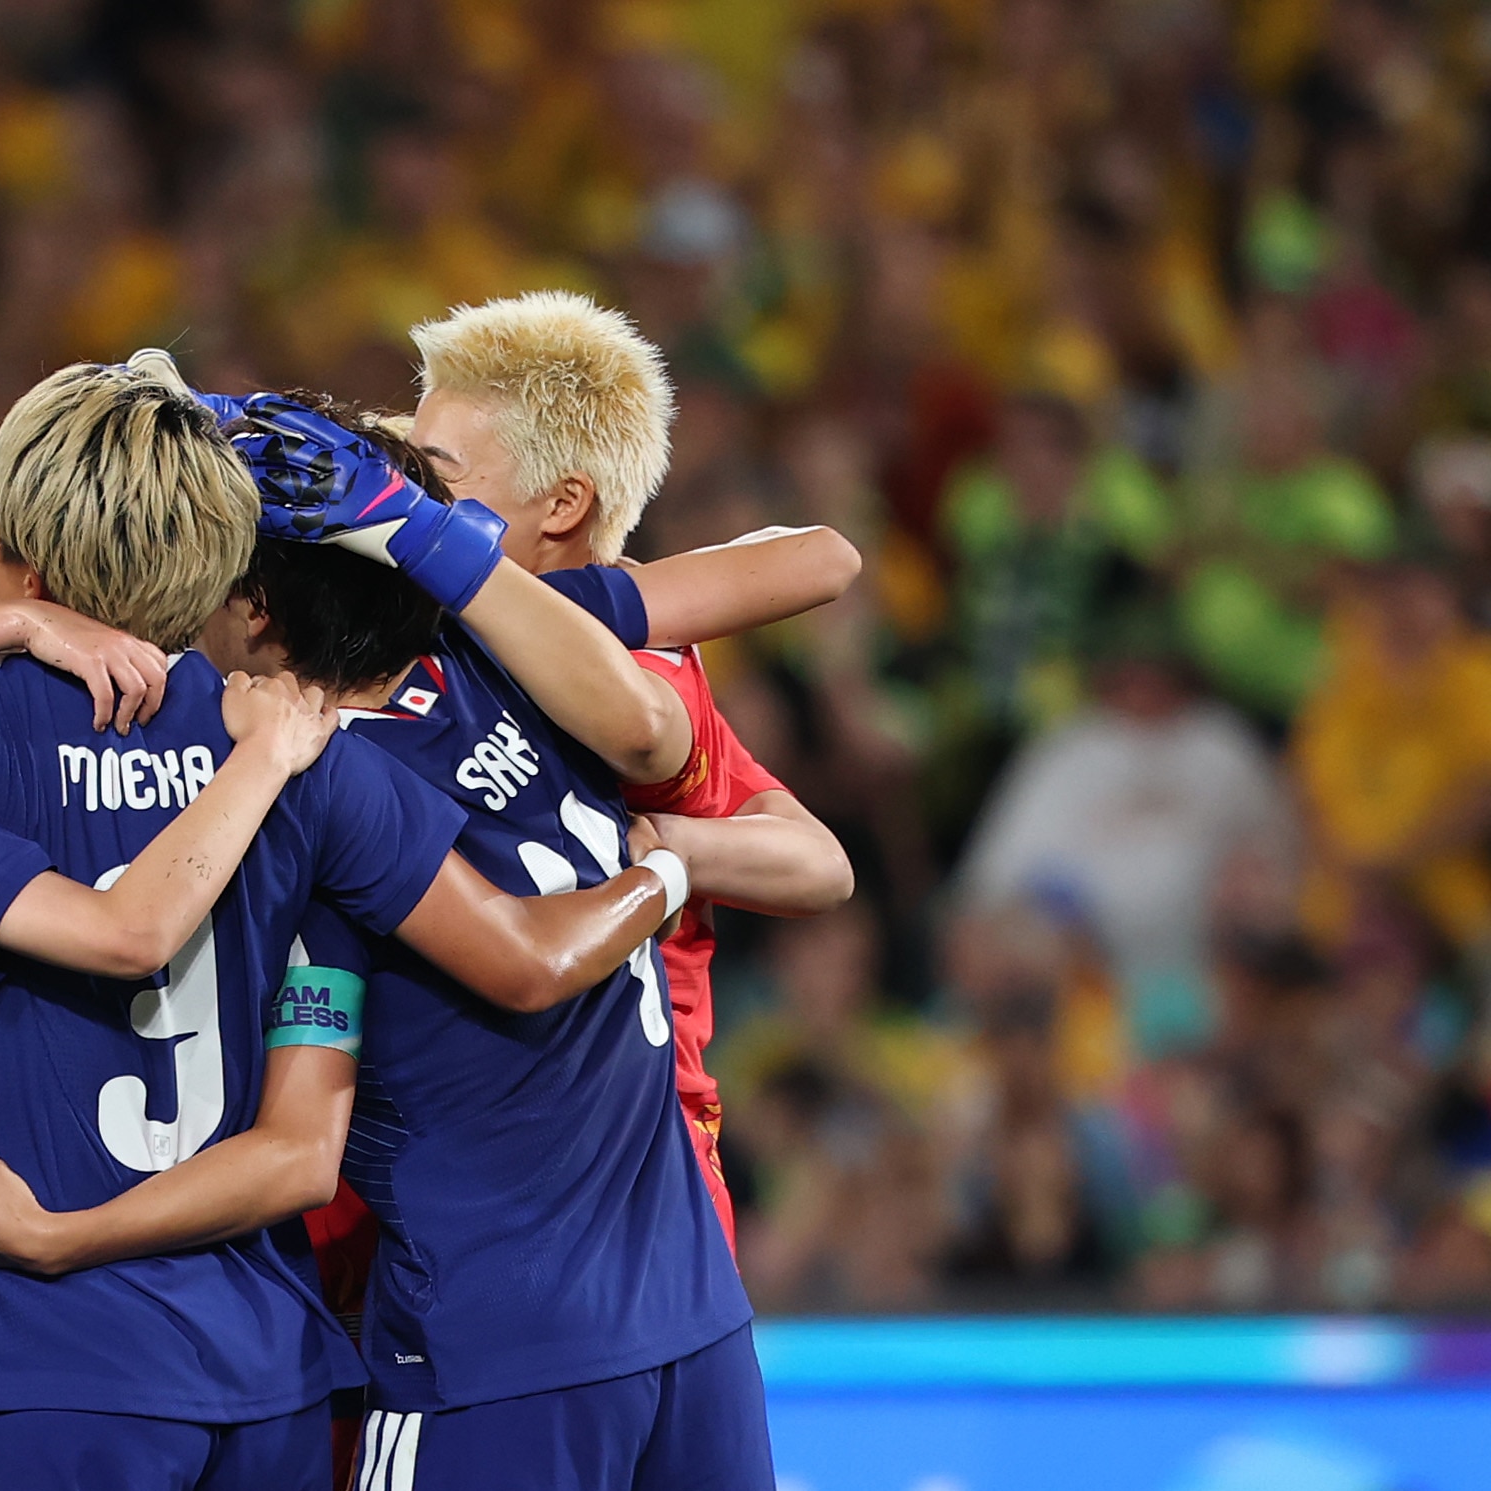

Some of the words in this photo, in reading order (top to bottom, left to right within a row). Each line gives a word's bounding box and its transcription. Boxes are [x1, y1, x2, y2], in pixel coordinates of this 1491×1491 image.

[57, 744, 215, 811] MOEKA
[456, 710, 540, 811] SAK
[274, 1006, 349, 1032] LESS
[275, 985, 331, 1007] AM
